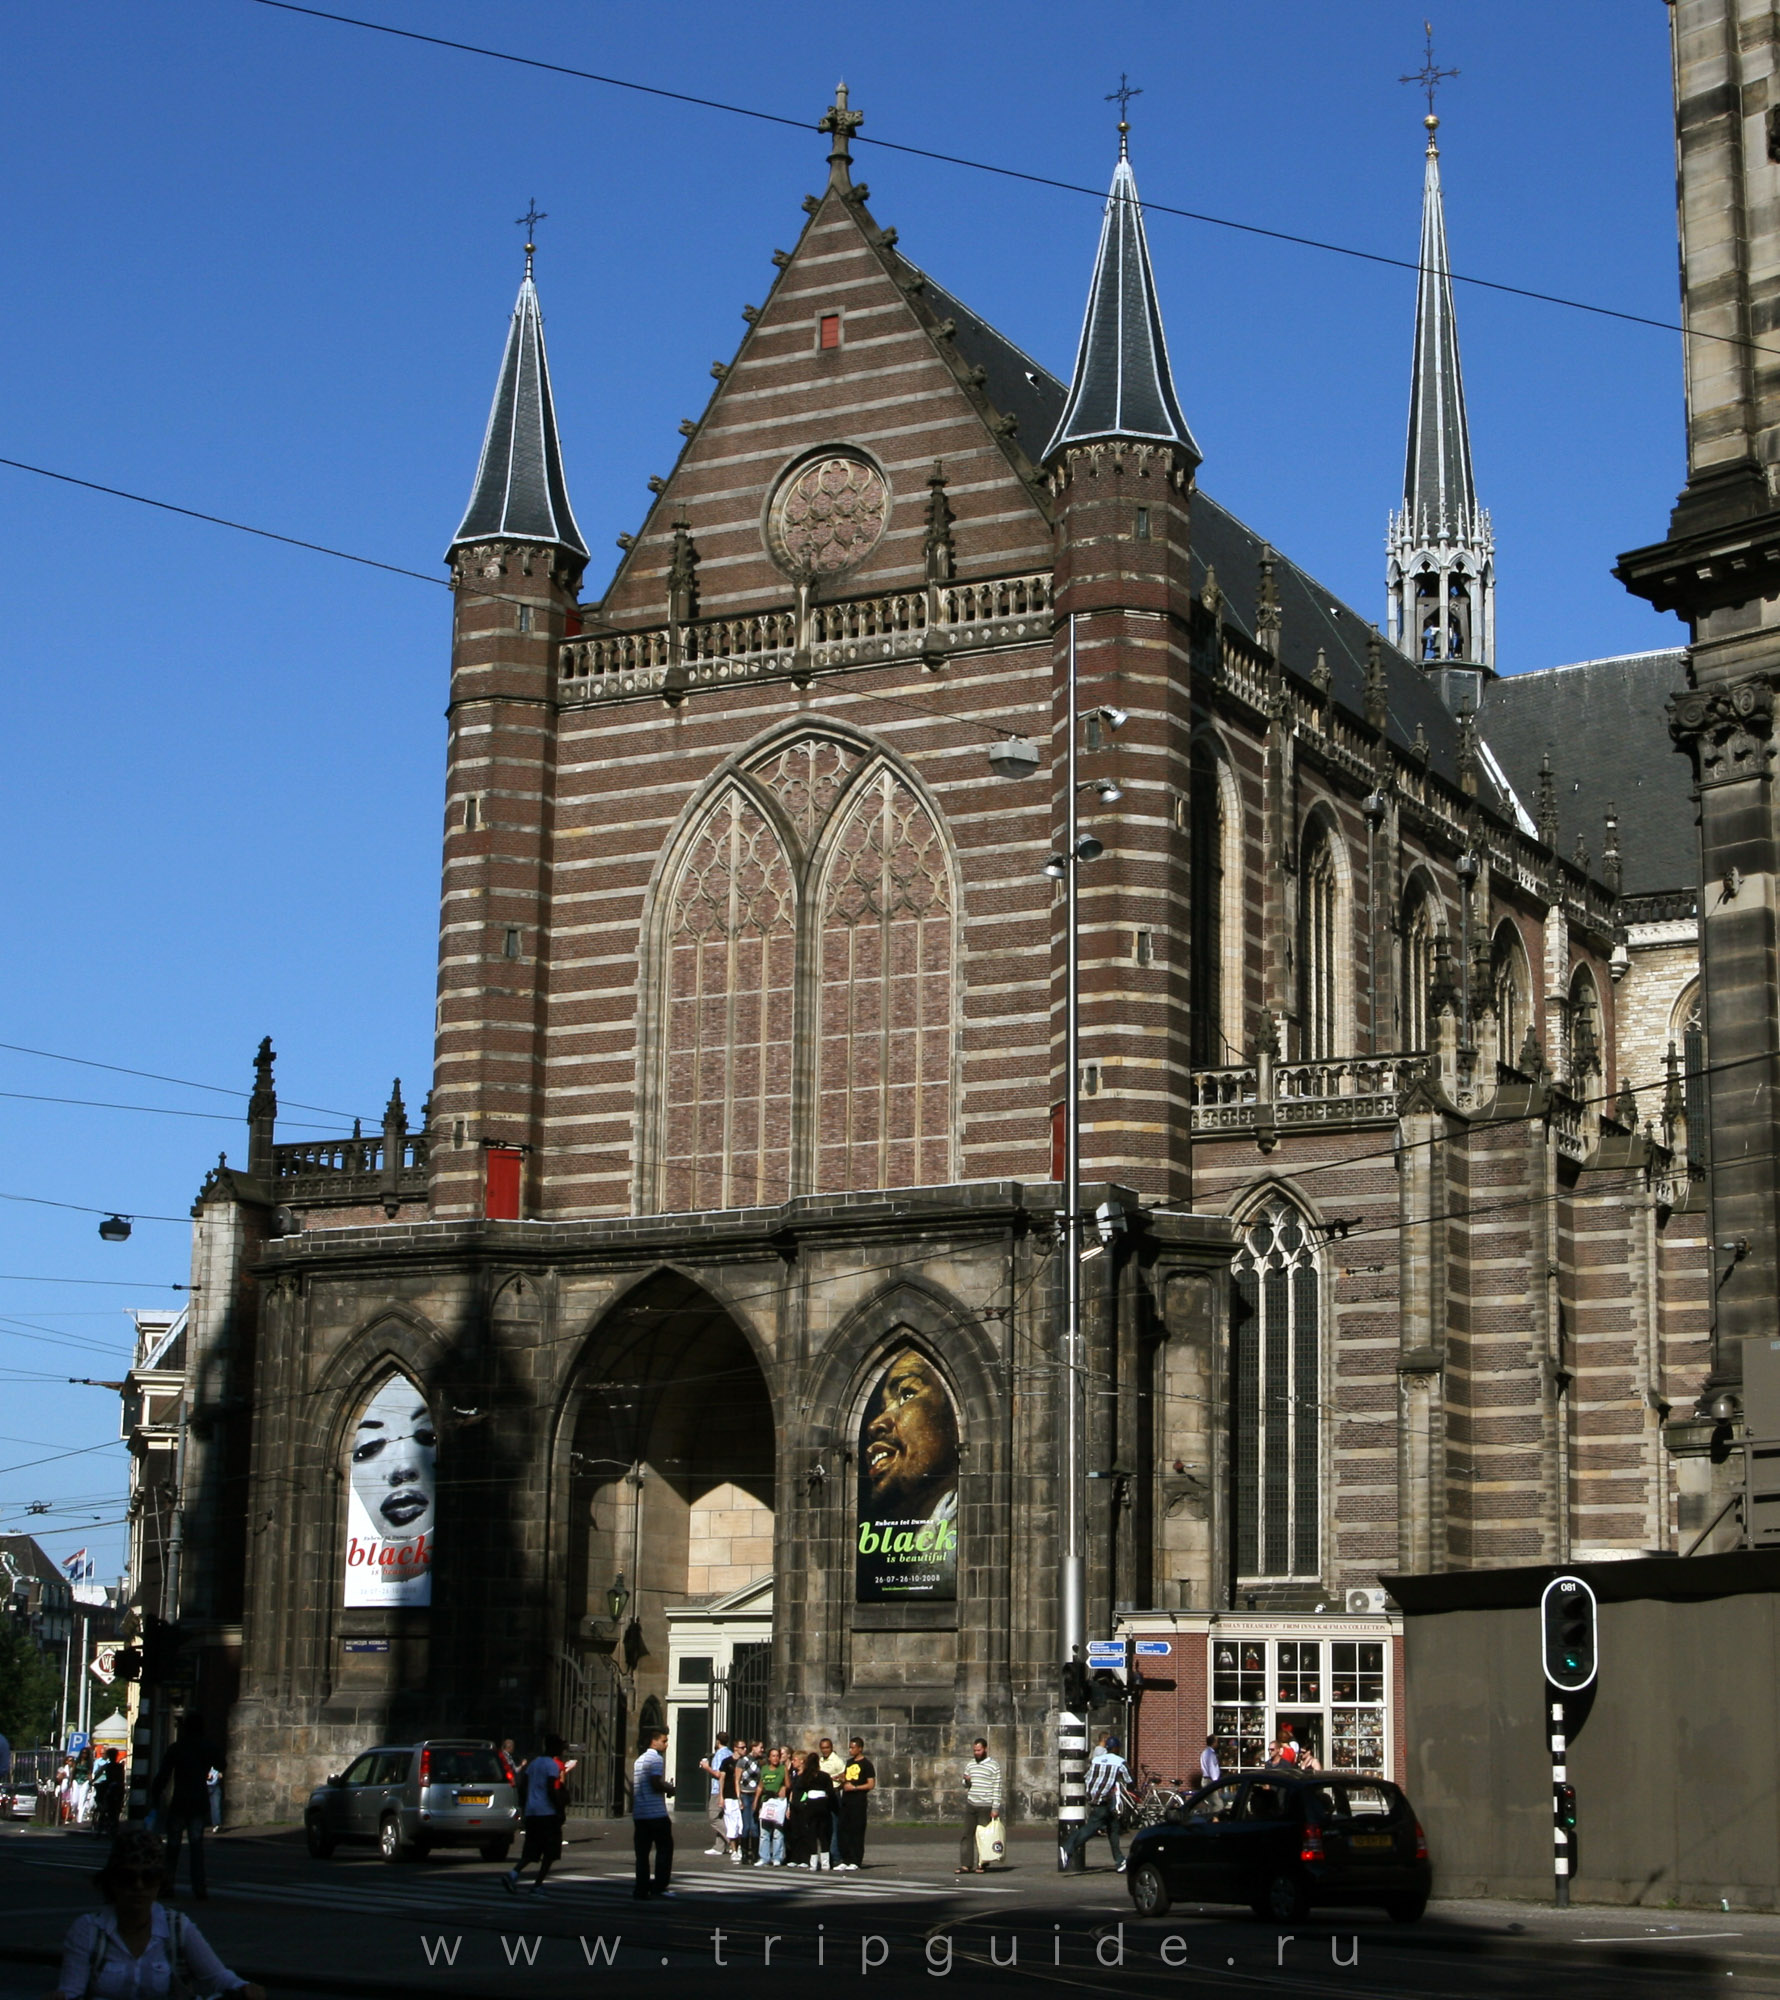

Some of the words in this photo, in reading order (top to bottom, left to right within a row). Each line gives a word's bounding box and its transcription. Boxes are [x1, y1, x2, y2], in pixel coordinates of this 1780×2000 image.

[858, 1519, 957, 1554] black
[348, 1535, 433, 1567] black
[886, 1554, 896, 1563] is
[899, 1552, 947, 1564] beautiful
[1560, 1582, 1576, 1592] 081
[73, 1735, 83, 1748] P
